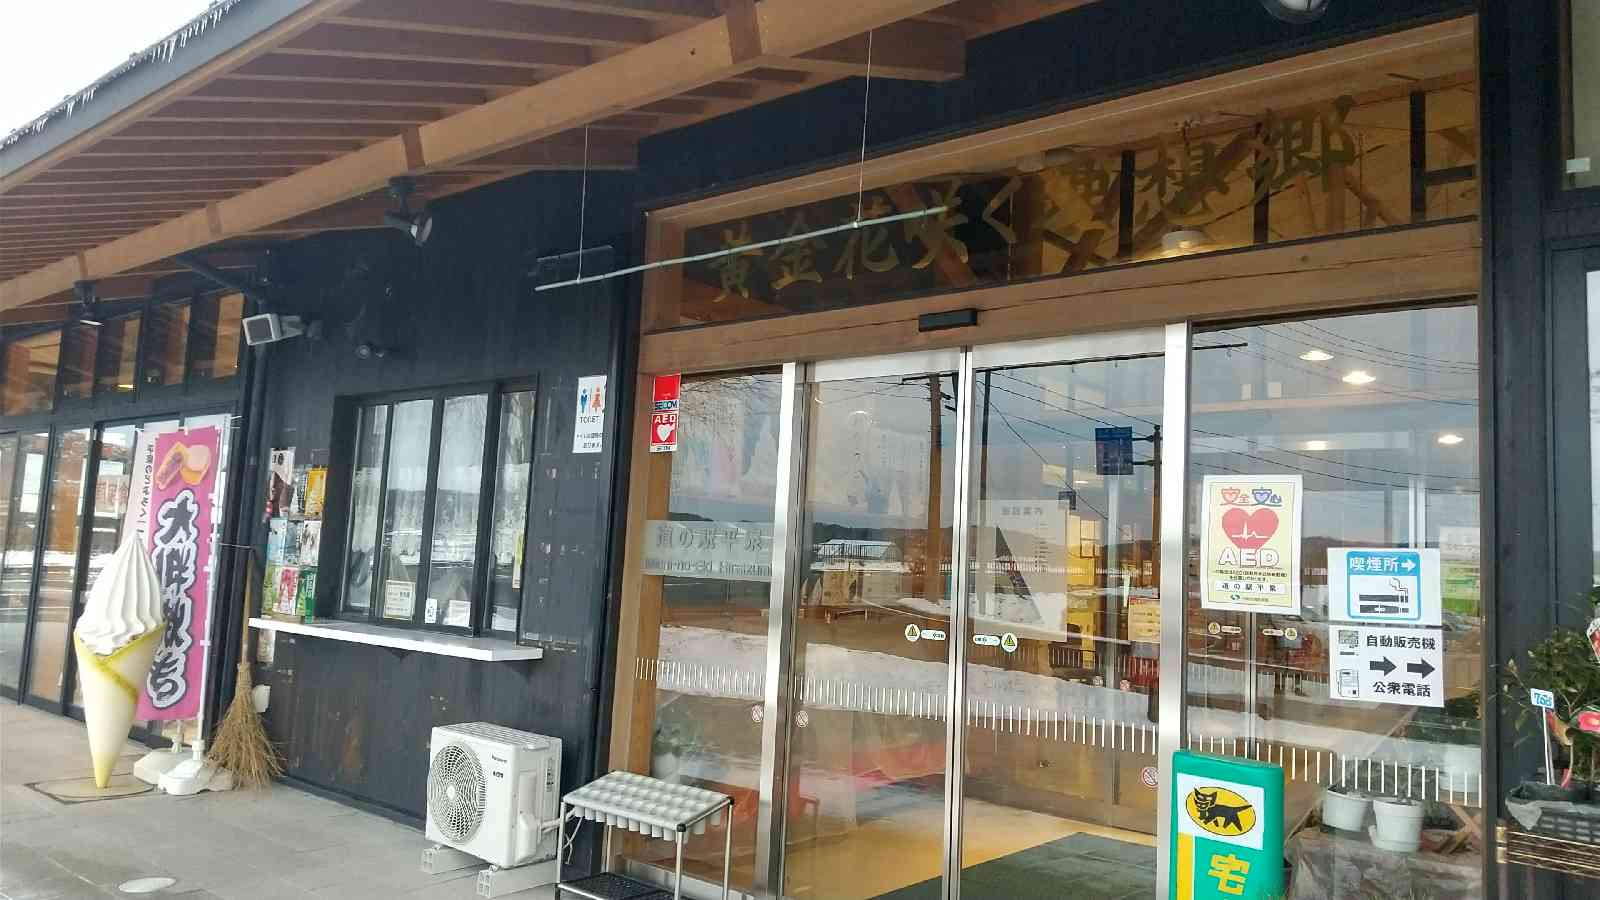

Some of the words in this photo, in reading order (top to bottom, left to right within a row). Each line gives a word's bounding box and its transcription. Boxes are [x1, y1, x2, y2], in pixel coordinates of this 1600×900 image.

[654, 414, 676, 424] AED
[1218, 547, 1280, 569] AED
[1350, 556, 1400, 573] 喫煙所
[1366, 634, 1437, 651] 自動販売機
[1372, 681, 1432, 698] 公衆電話
[1207, 853, 1251, 897] 宅
